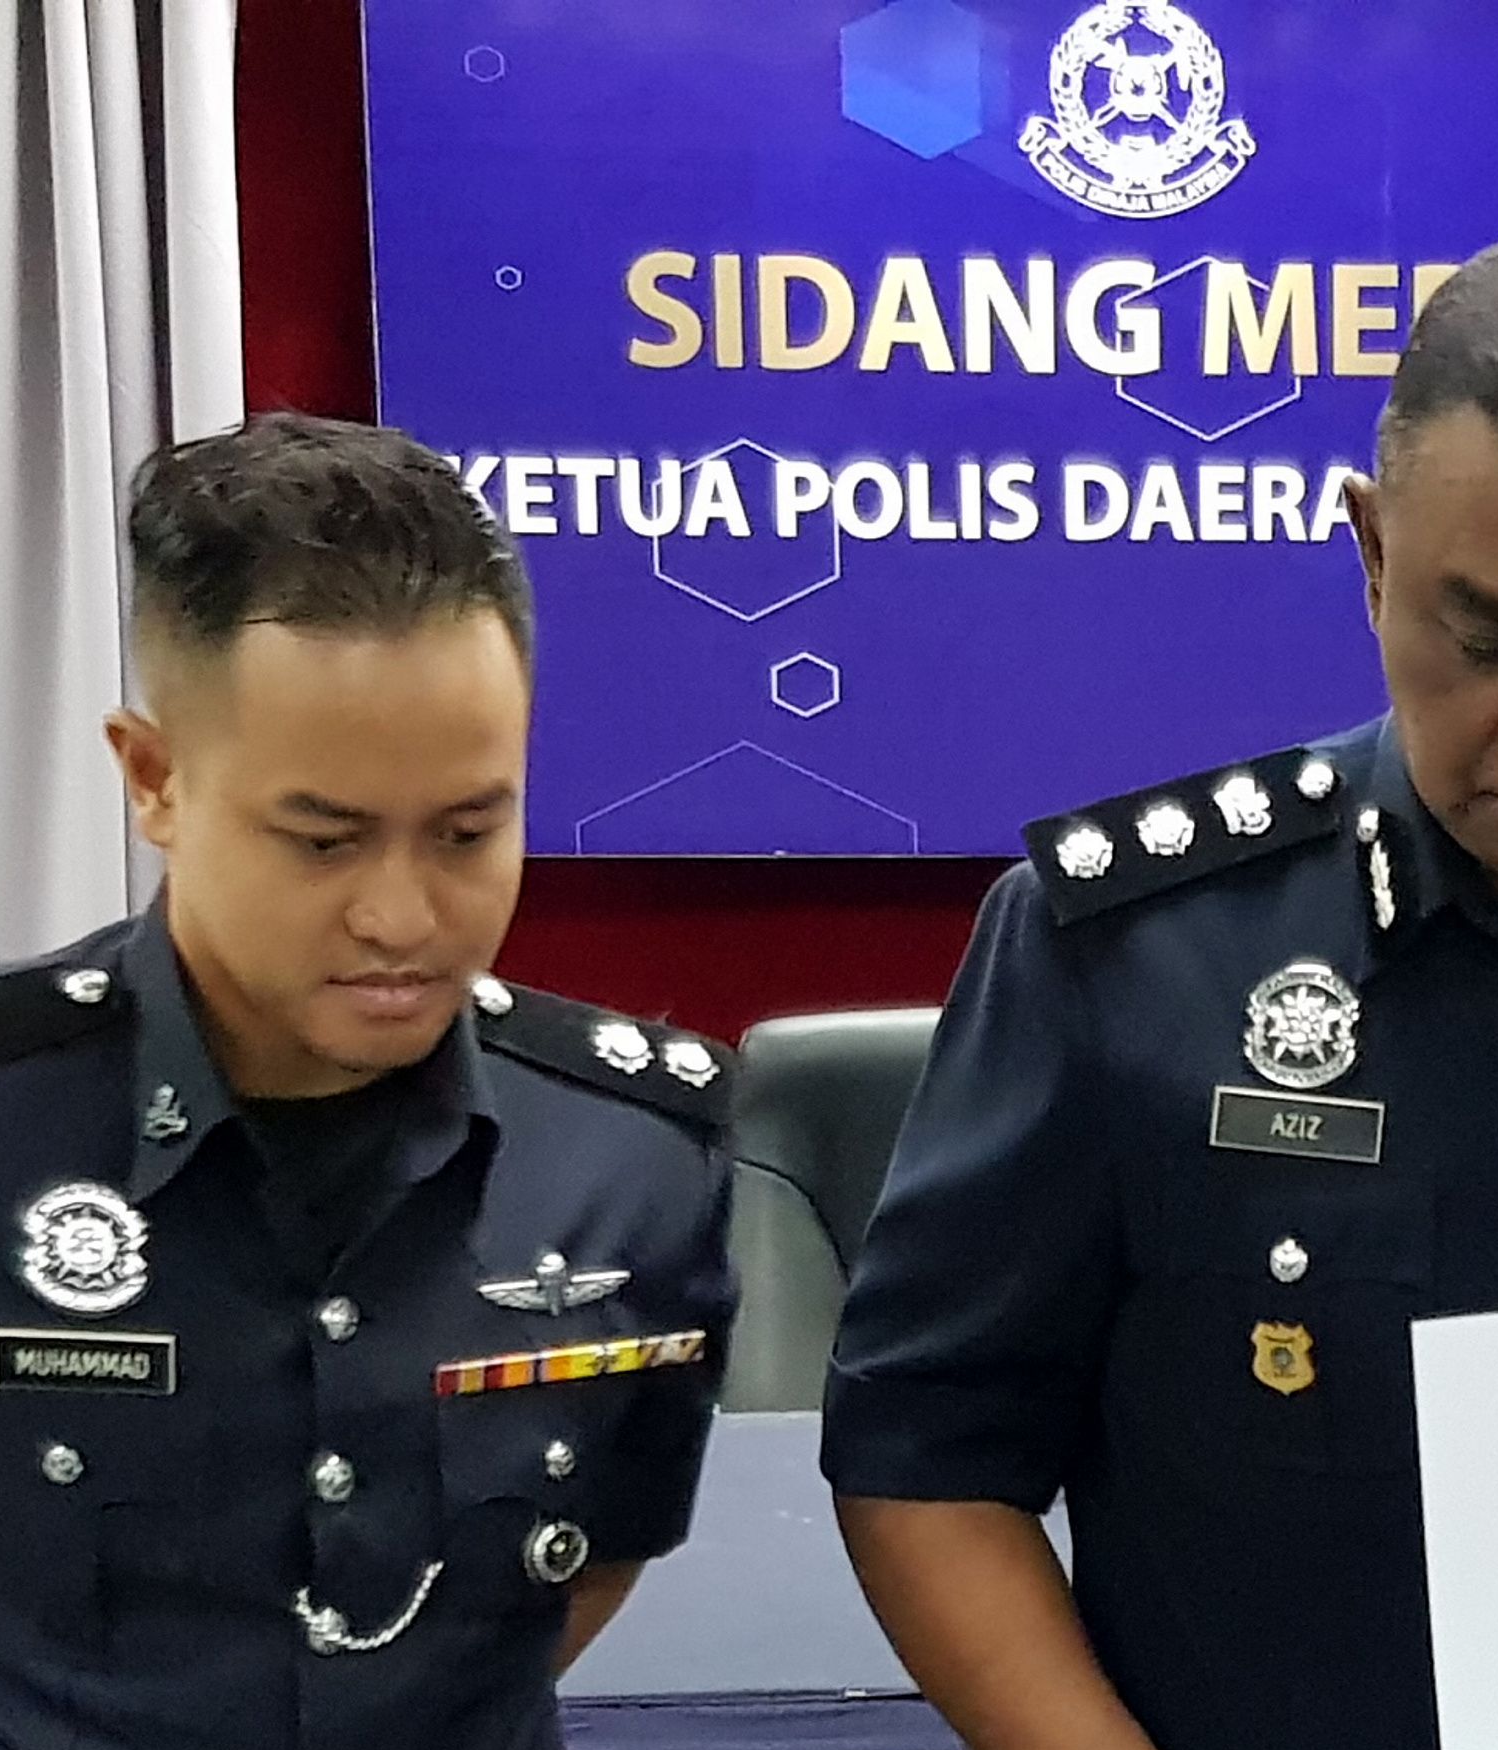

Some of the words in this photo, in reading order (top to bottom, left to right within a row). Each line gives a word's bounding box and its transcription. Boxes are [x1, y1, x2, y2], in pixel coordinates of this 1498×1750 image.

[624, 250, 1163, 376] SIDANG
[440, 454, 754, 537] KETUA
[774, 458, 1040, 541] POLIS
[1064, 462, 1360, 543] DAERA
[1269, 1109, 1324, 1142] AZIZ
[12, 1347, 152, 1382] MUHAMMAD
